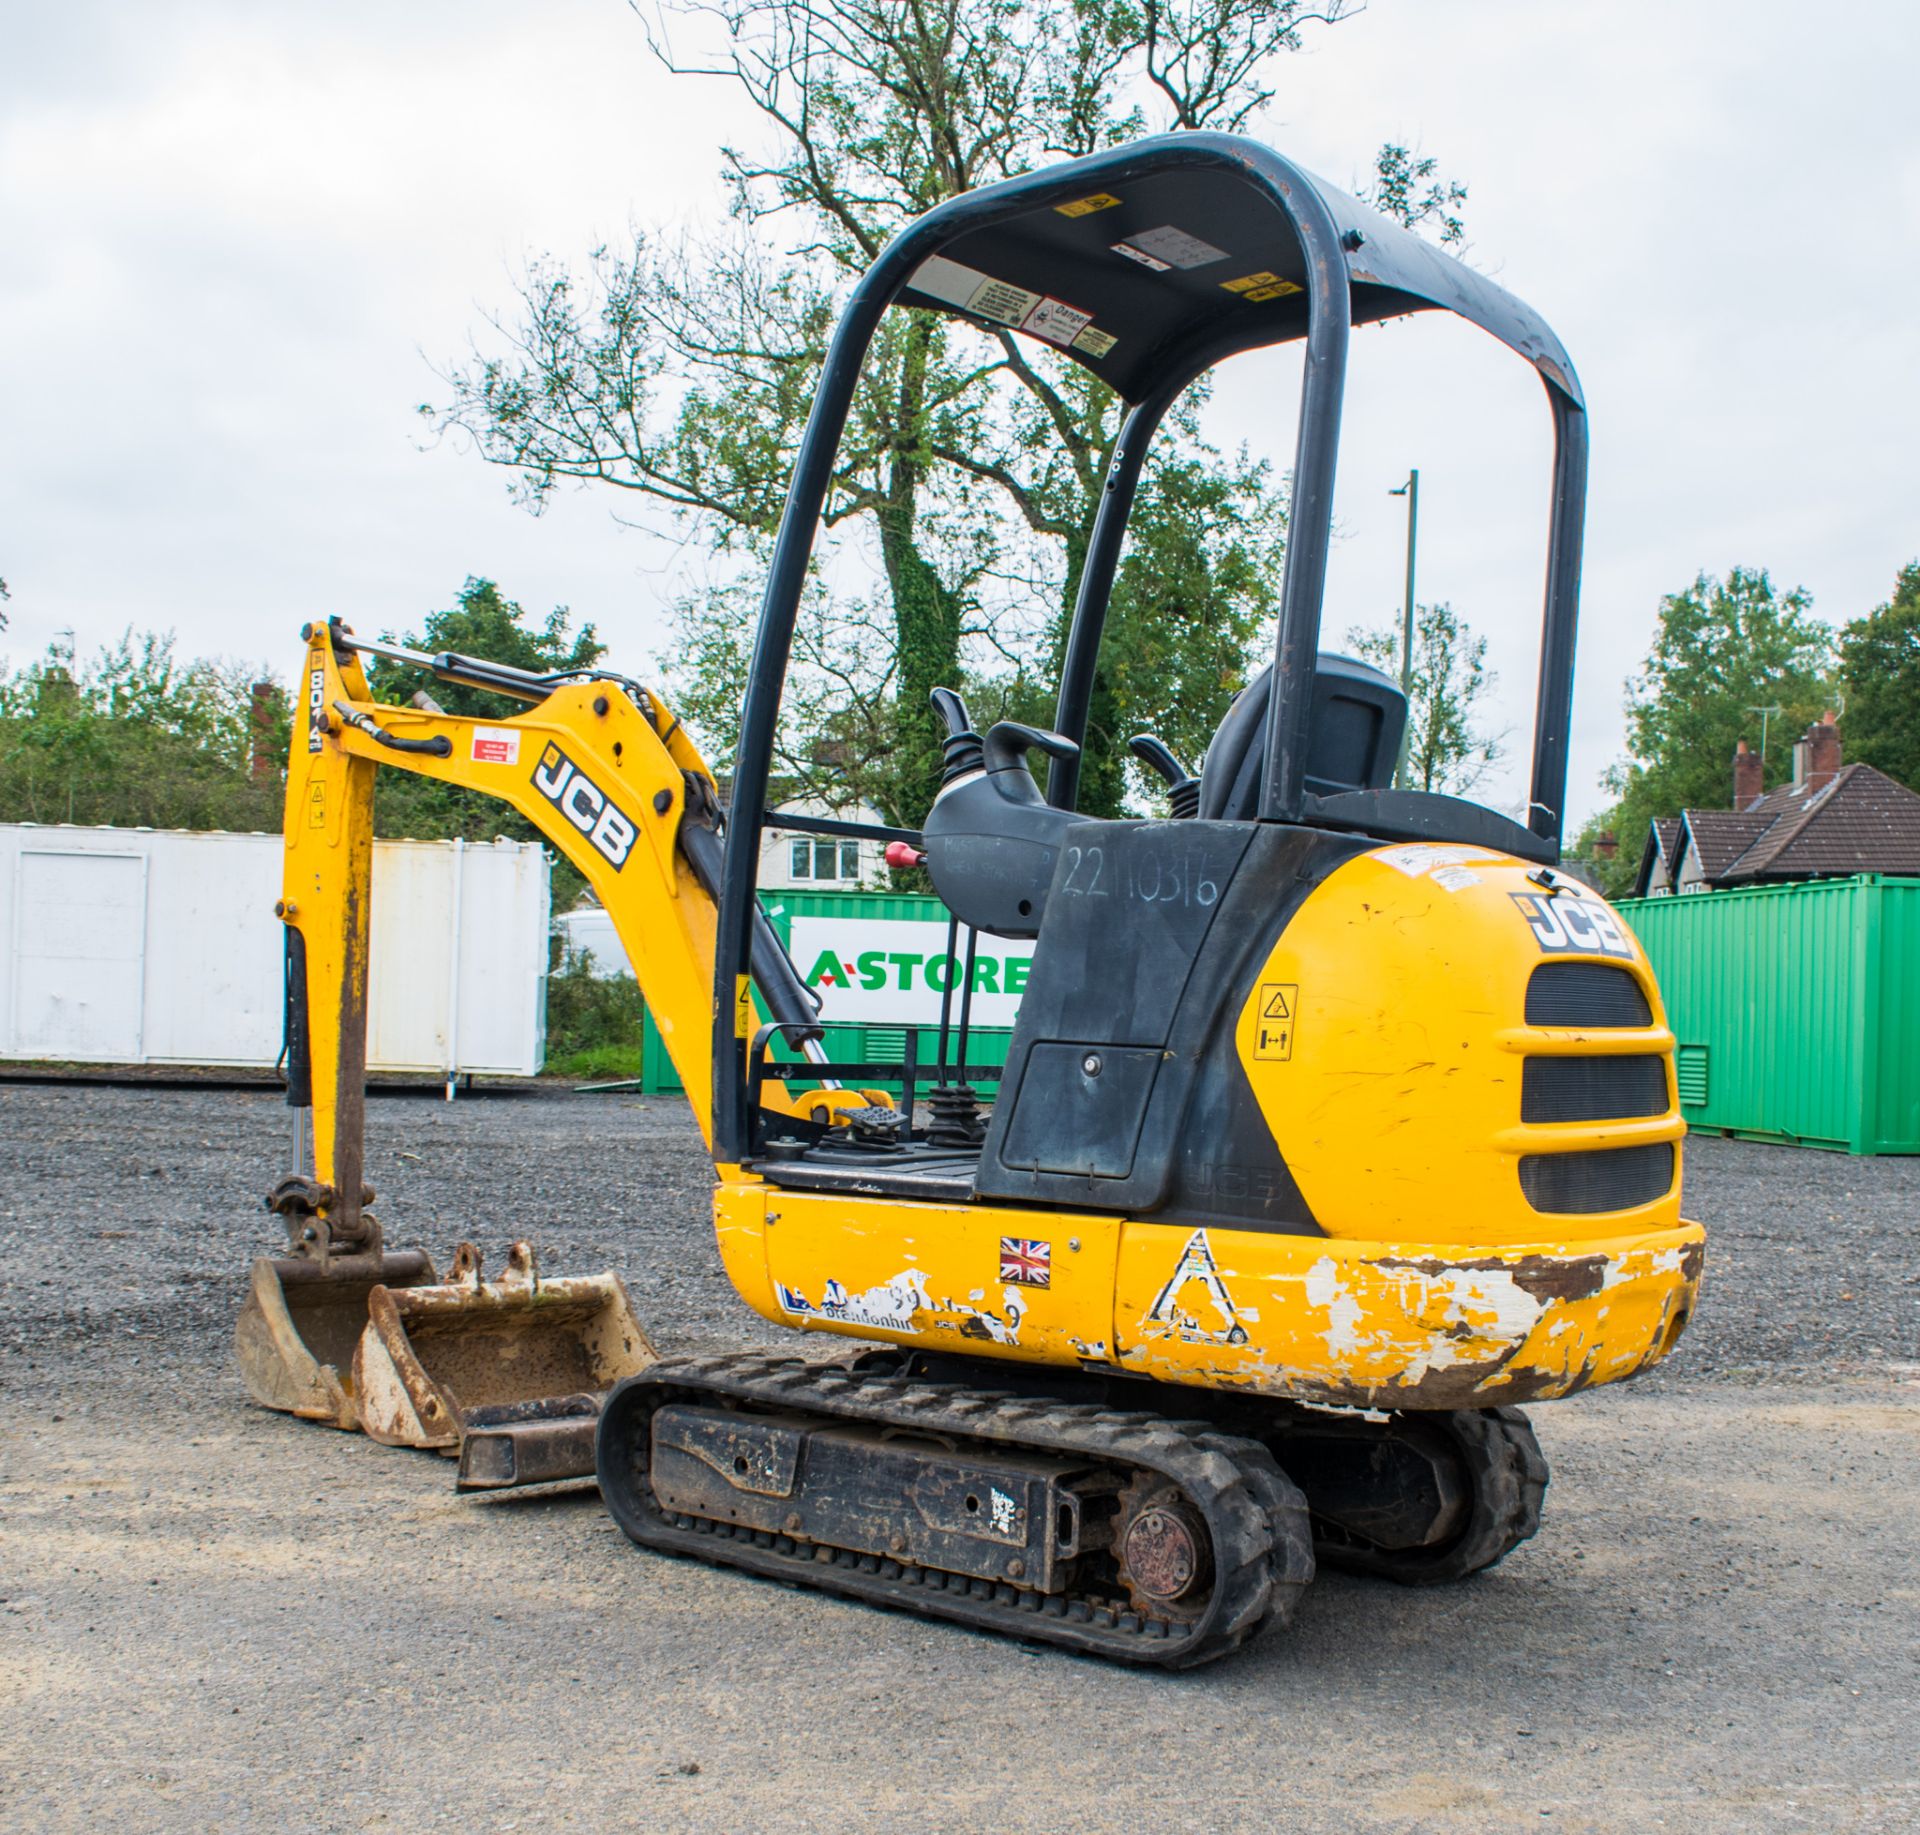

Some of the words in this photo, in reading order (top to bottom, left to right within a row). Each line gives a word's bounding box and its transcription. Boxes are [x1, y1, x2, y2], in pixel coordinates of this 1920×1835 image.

[1055, 305, 1088, 325] Danger
[535, 760, 635, 865] JCB
[1531, 896, 1627, 953] JCB
